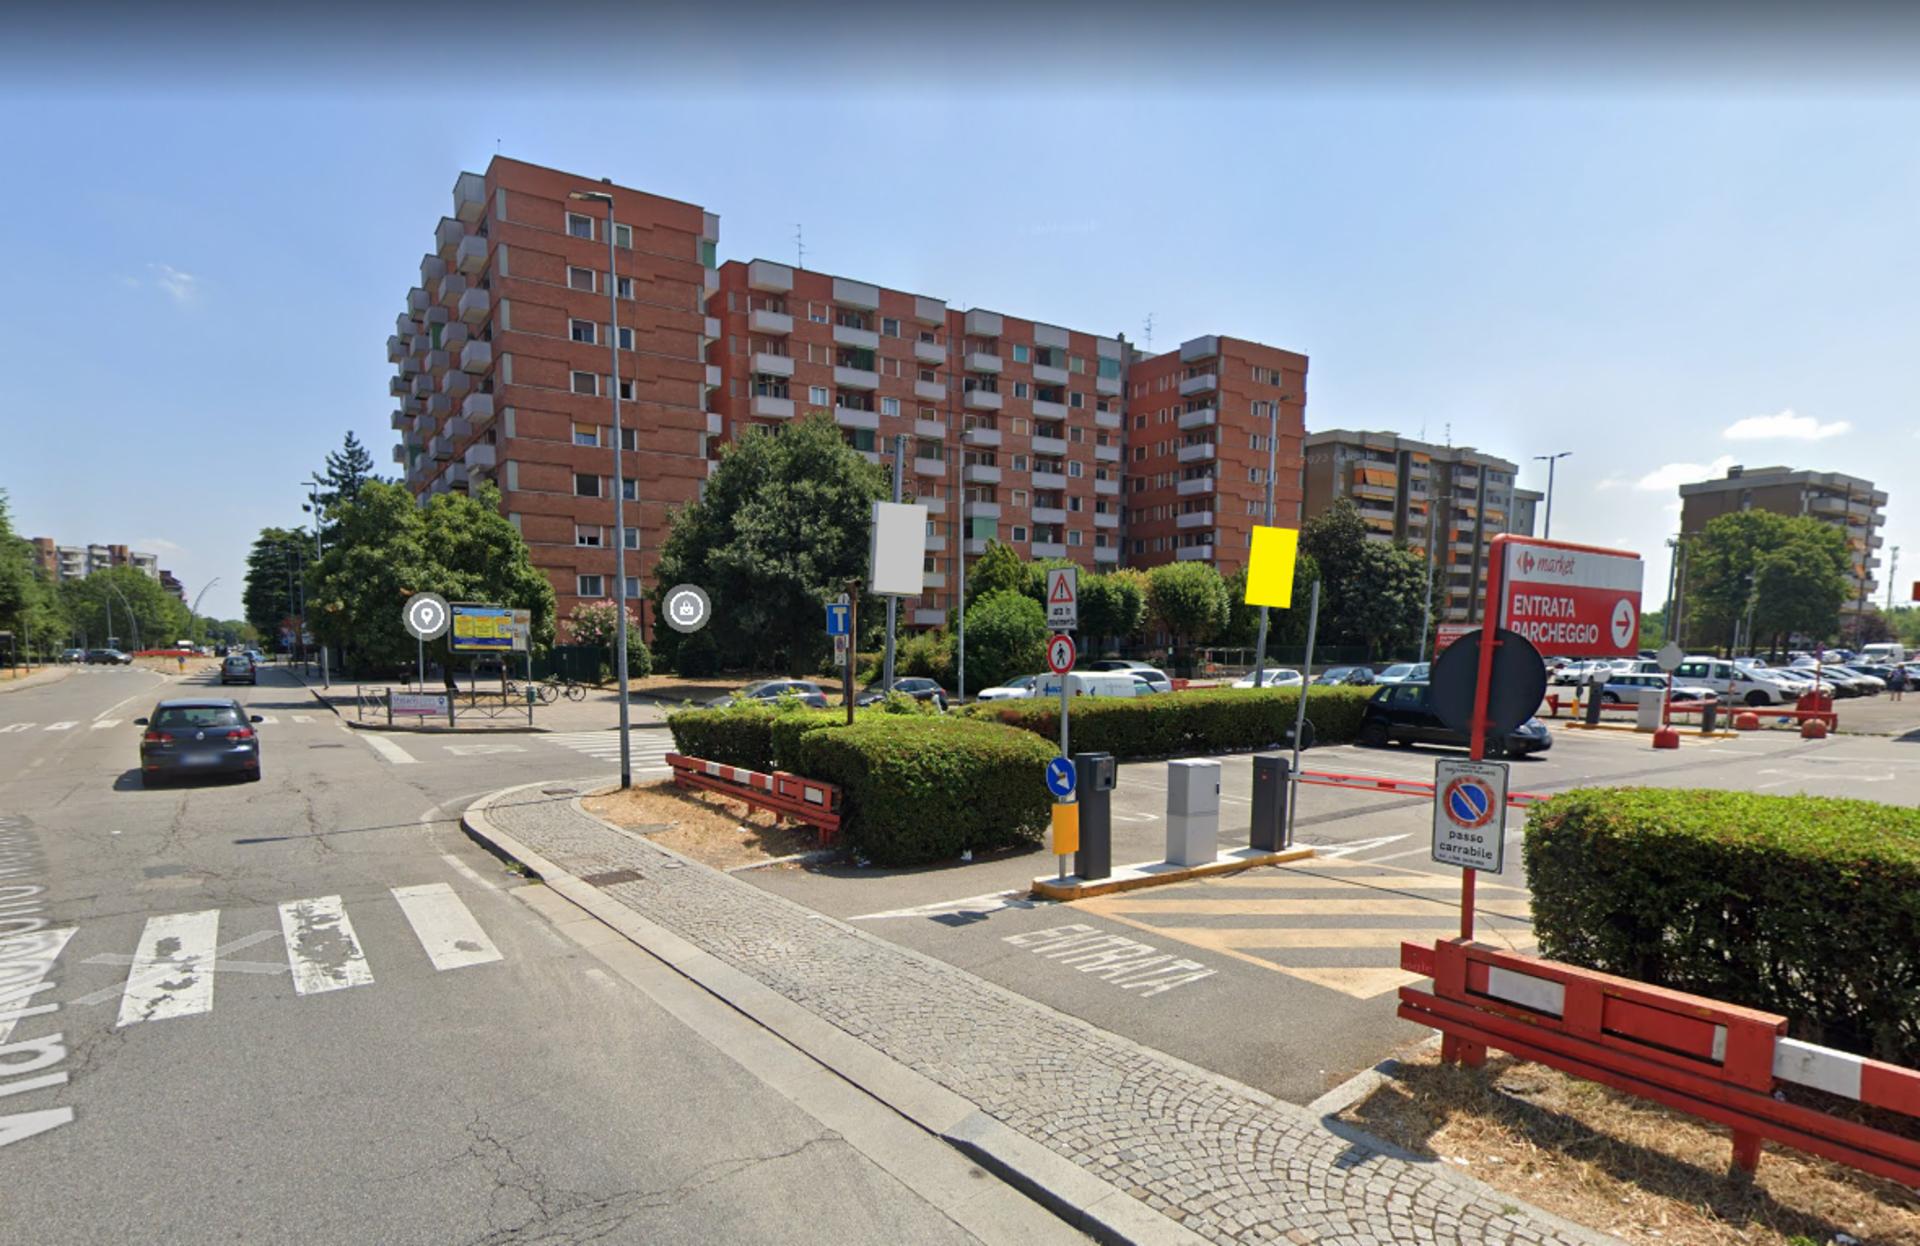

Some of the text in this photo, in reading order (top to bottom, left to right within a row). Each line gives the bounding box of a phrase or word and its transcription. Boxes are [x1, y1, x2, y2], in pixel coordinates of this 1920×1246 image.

[1537, 554, 1576, 576] market
[1512, 594, 1576, 618] ENTRATA
[1449, 830, 1484, 844] passo
[1439, 841, 1493, 860] carrabile
[1001, 923, 1218, 998] ENTRATA
